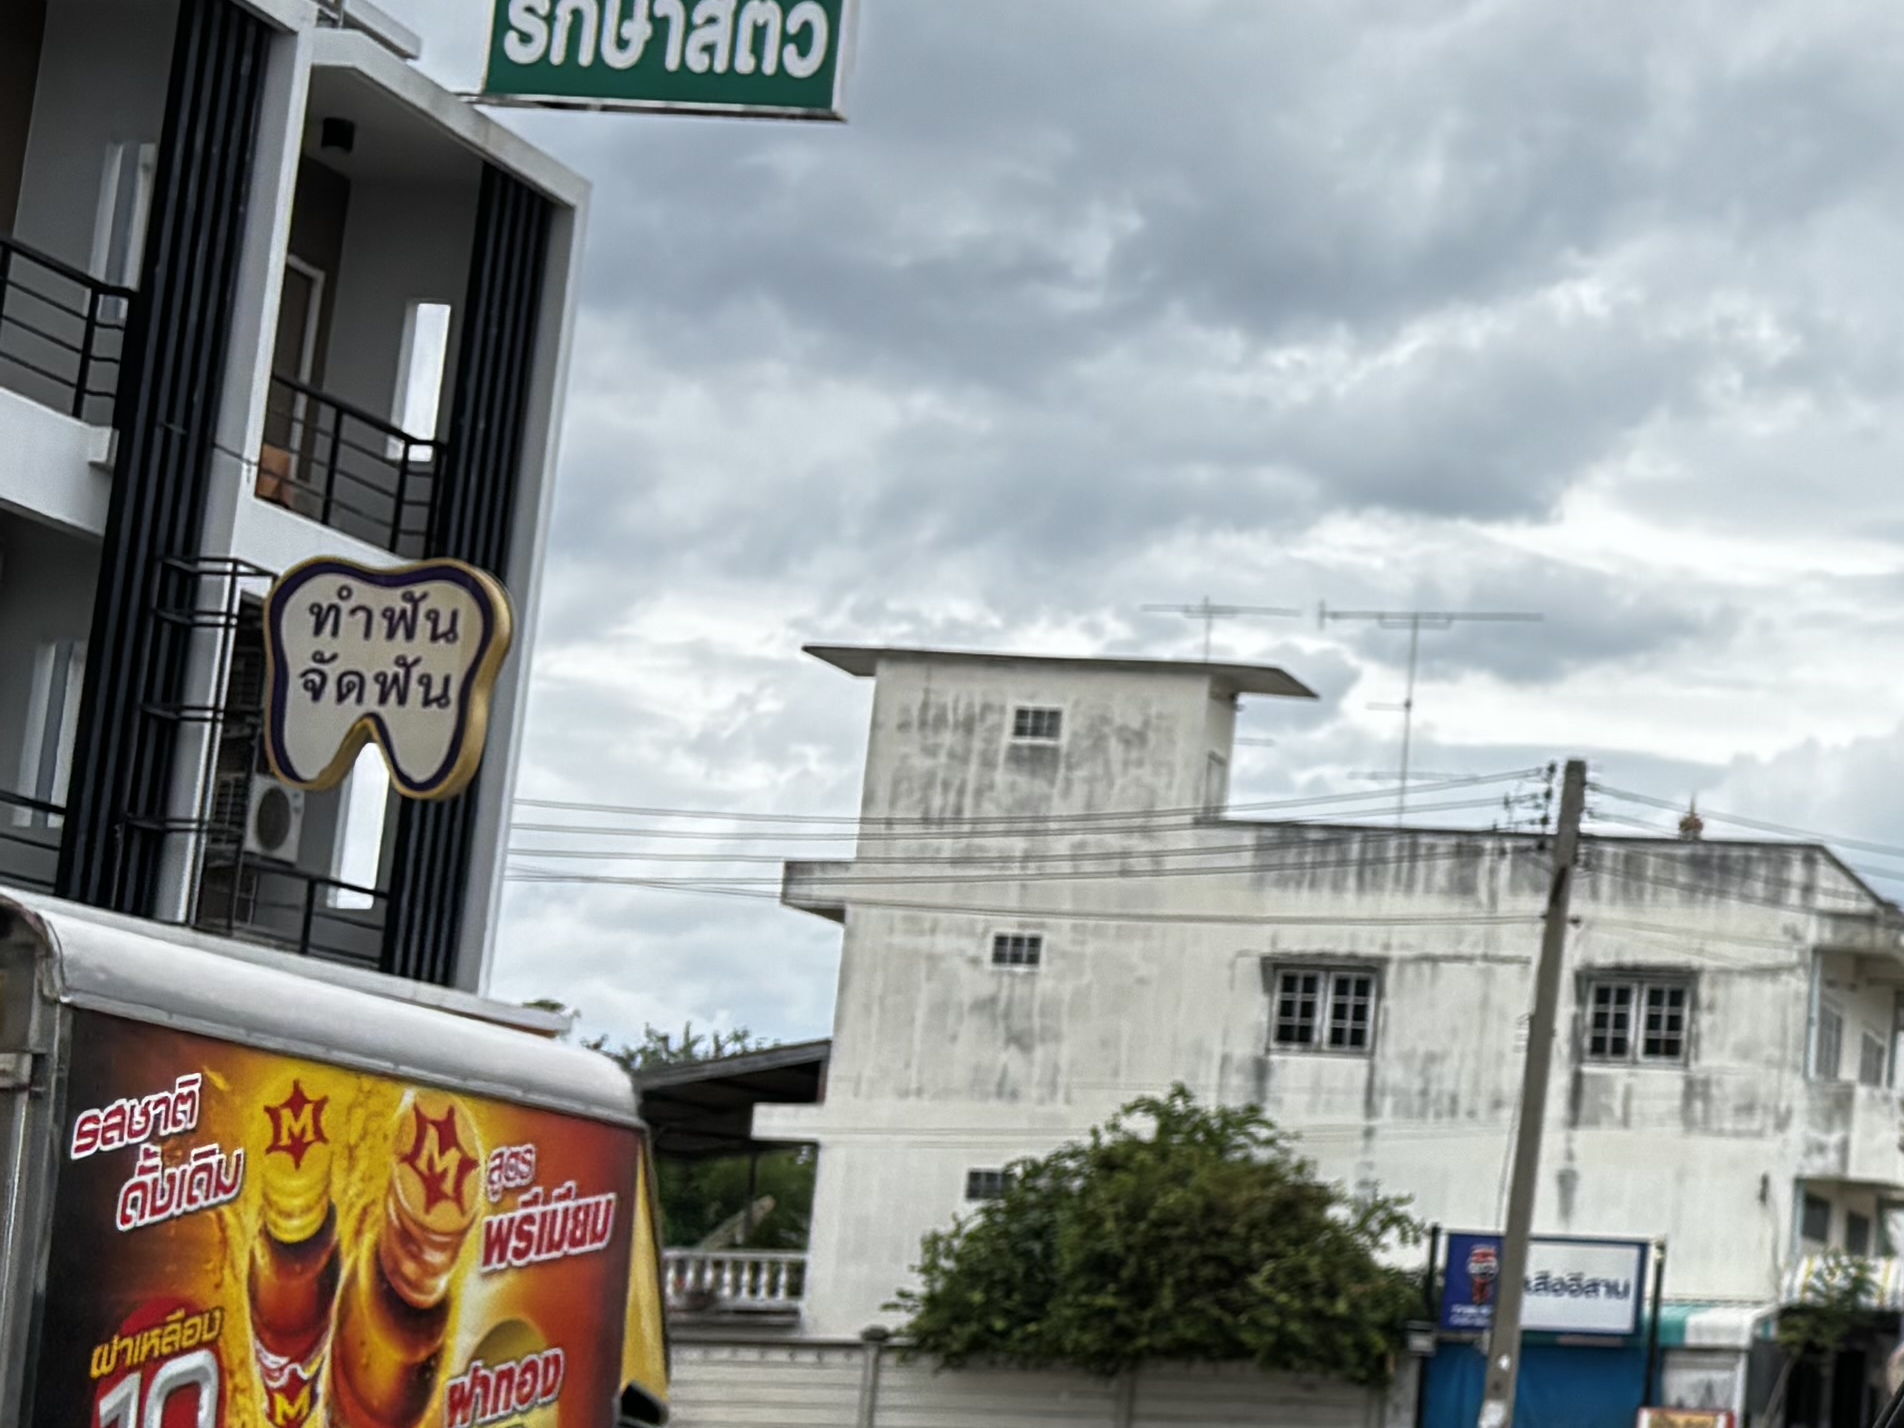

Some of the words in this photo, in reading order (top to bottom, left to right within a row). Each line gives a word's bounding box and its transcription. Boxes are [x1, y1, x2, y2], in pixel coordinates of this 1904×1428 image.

[307, 585, 461, 646] ทำฟัน
[298, 650, 454, 711] จัดฟัน
[115, 1143, 245, 1232] ดั้งเดิม
[481, 1179, 617, 1274] พรีเมียม
